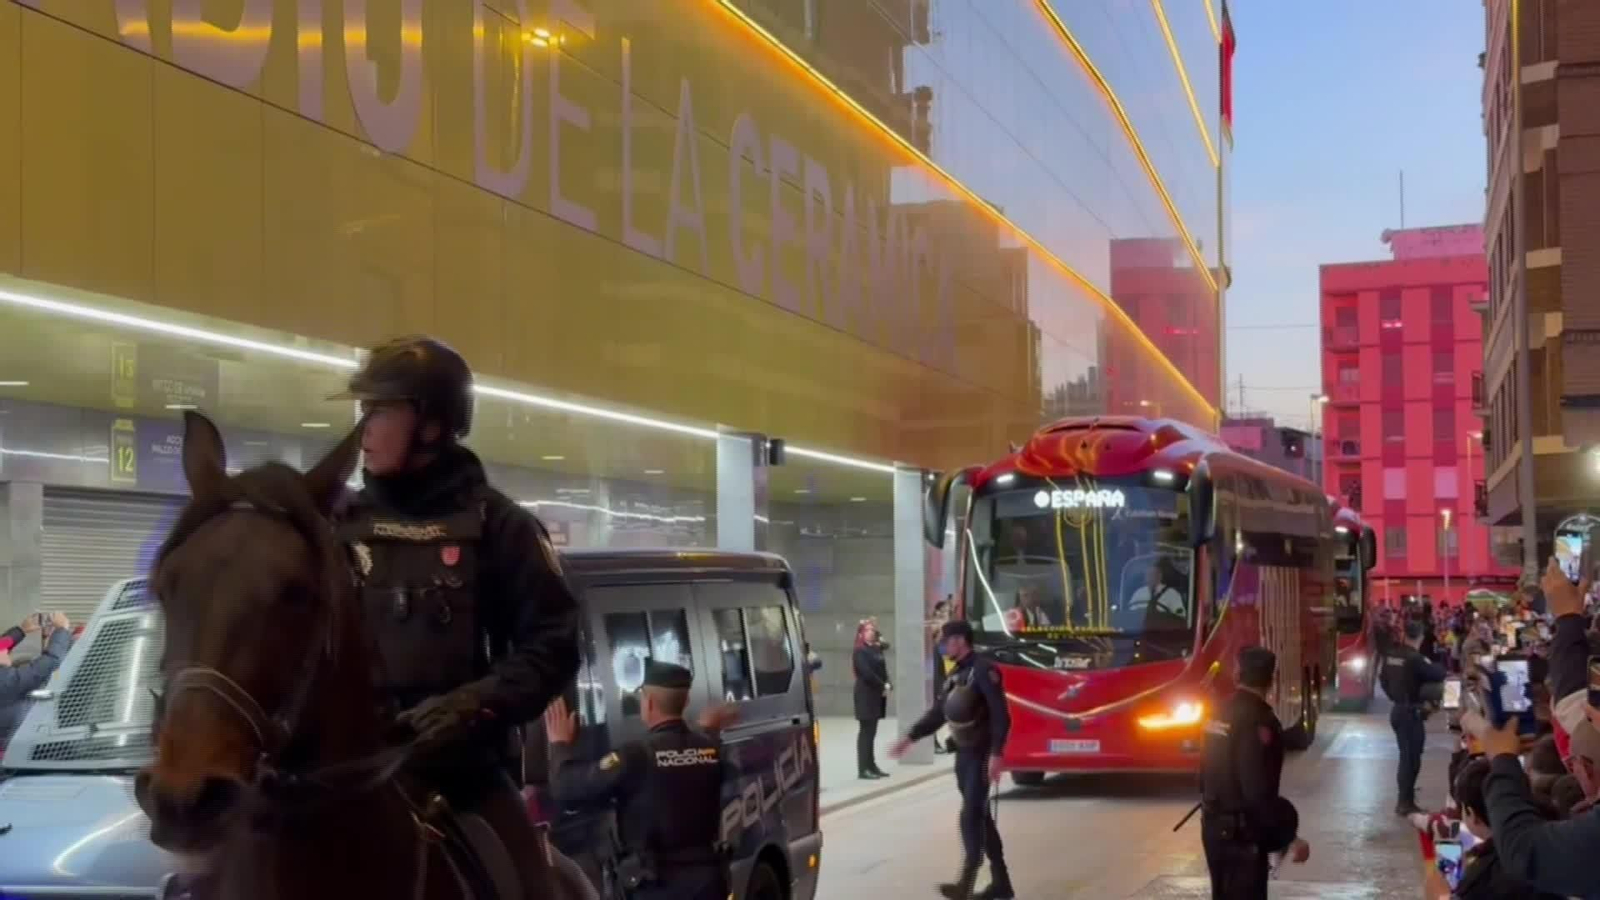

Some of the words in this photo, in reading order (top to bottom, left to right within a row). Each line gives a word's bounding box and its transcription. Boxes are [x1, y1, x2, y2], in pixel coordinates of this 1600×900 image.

[473, 0, 597, 233] DE
[620, 37, 711, 277] LA
[118, 447, 135, 472] 12
[657, 756, 718, 767] NACIONAL
